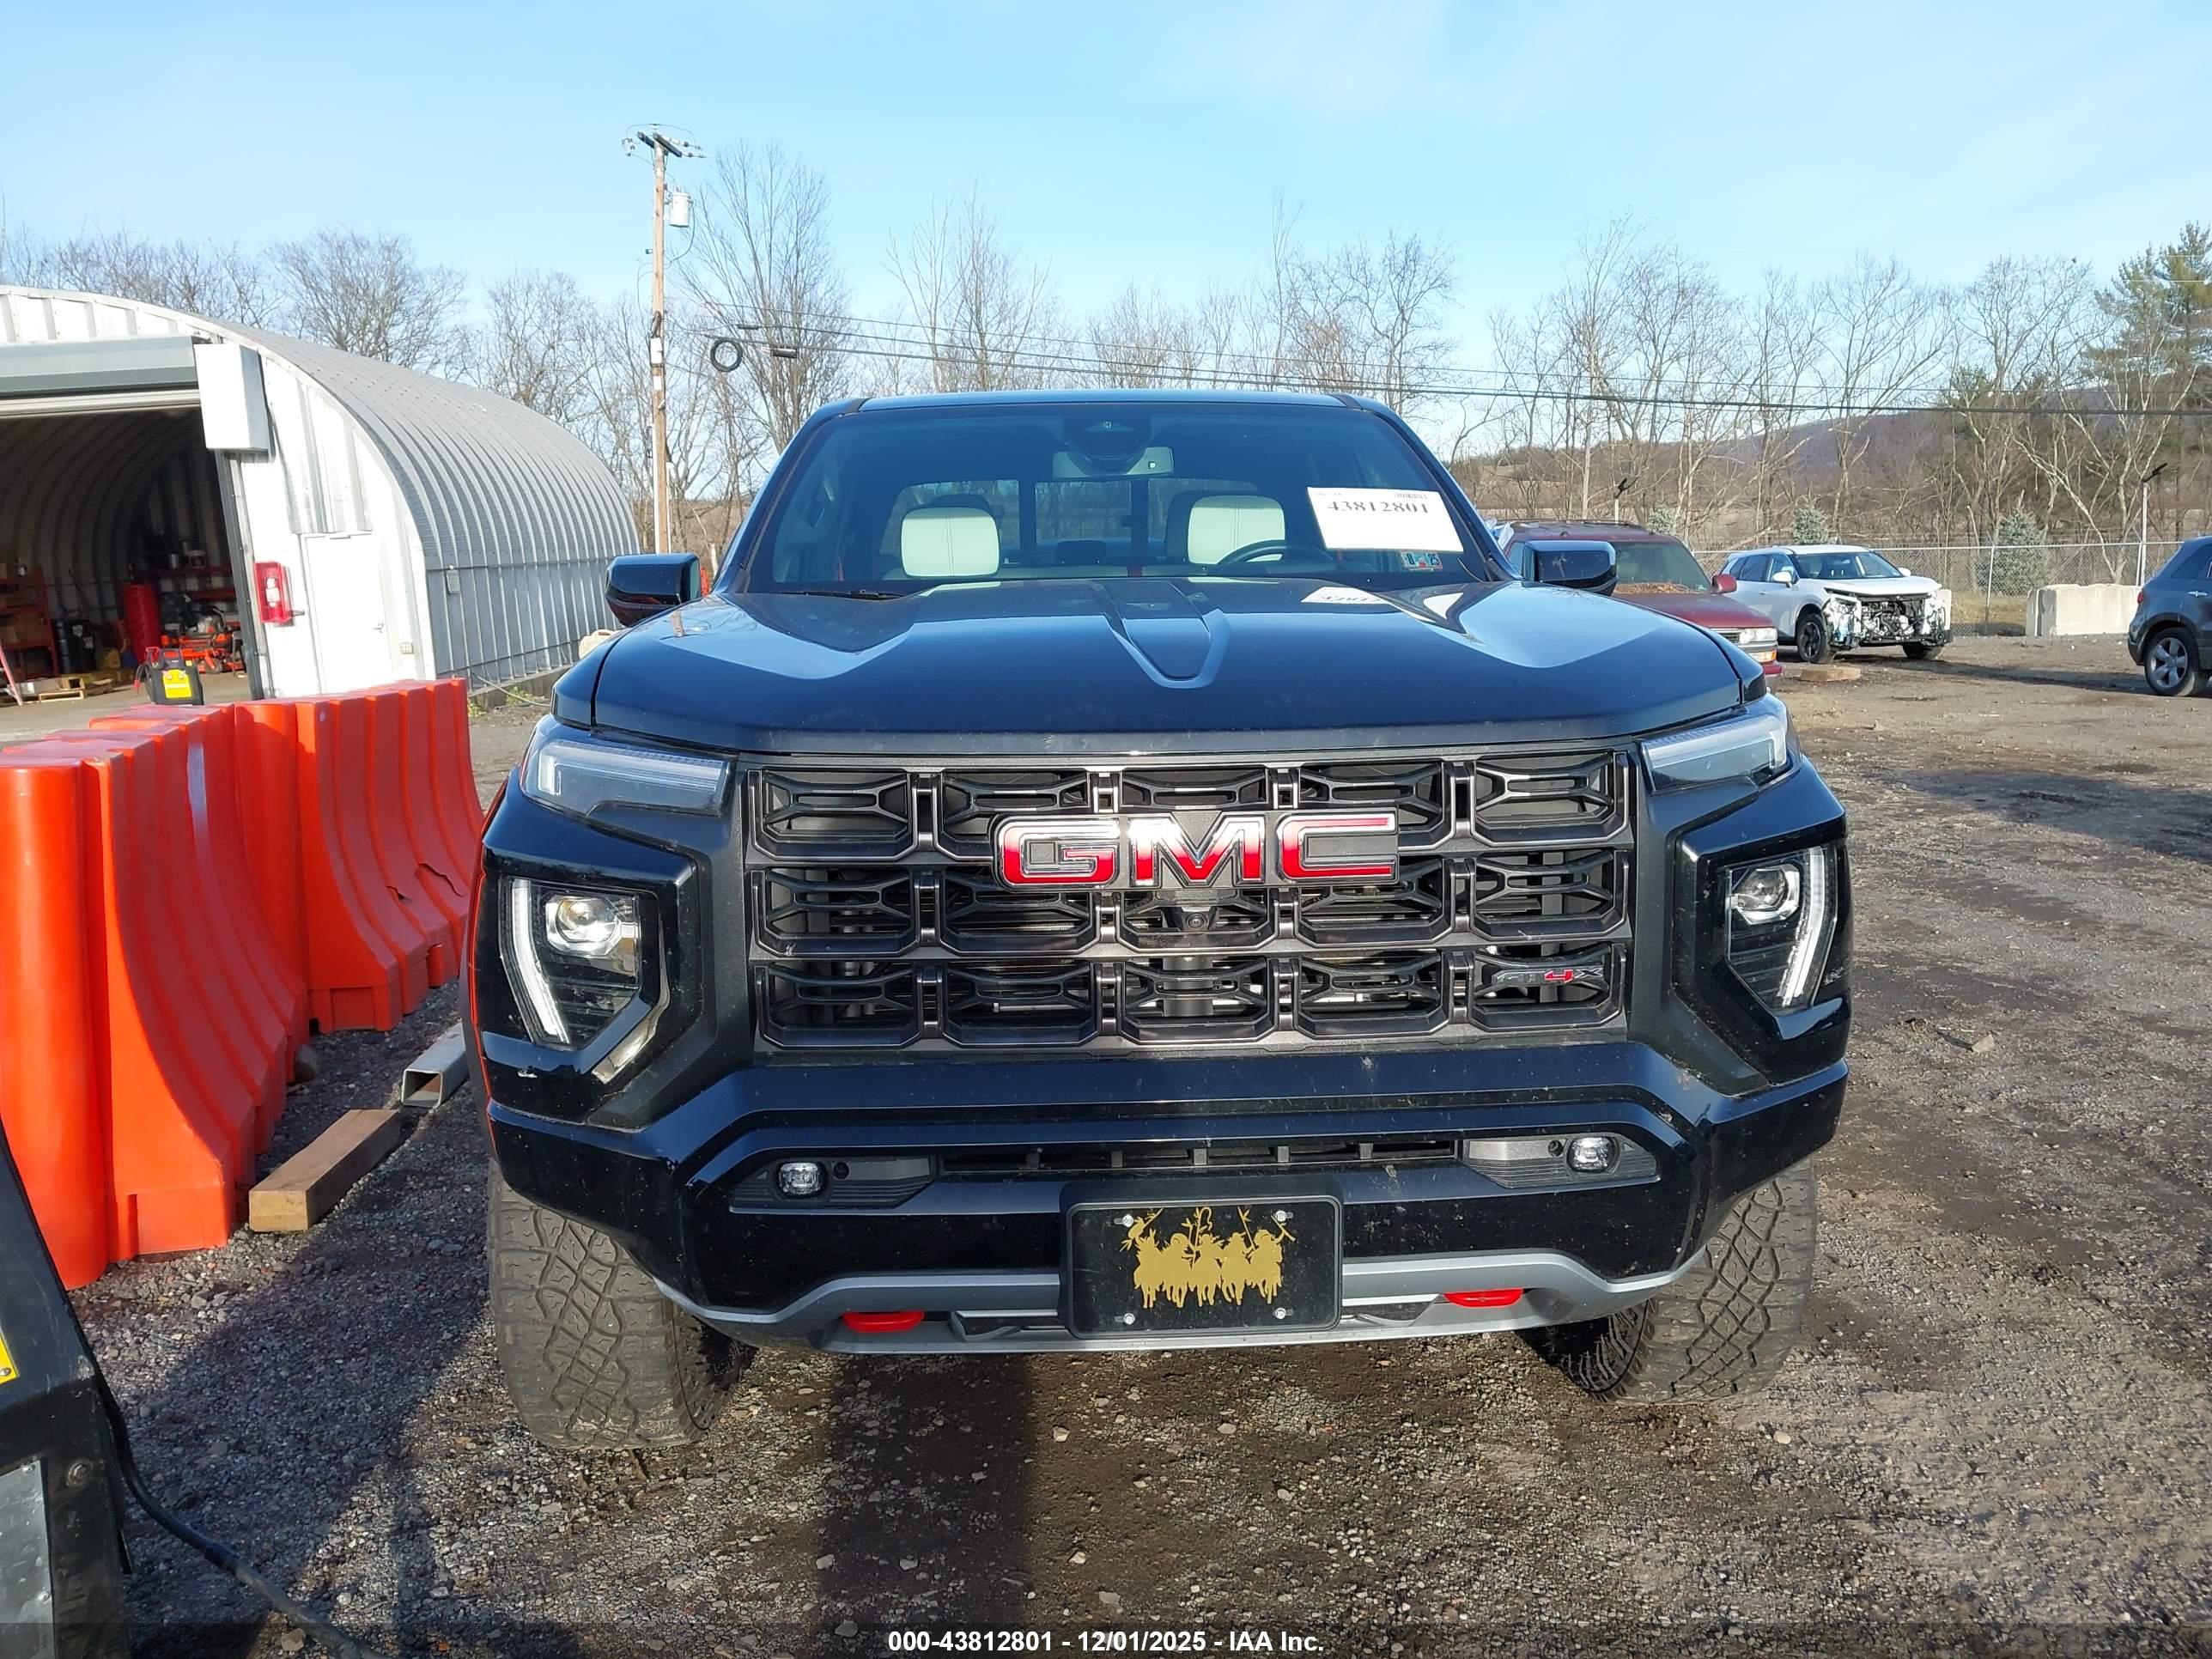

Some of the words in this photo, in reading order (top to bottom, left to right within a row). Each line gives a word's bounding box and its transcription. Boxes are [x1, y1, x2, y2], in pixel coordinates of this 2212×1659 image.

[1328, 501, 1429, 514] 43812801
[1428, 553, 1440, 566] 25
[998, 811, 1397, 886] GMC
